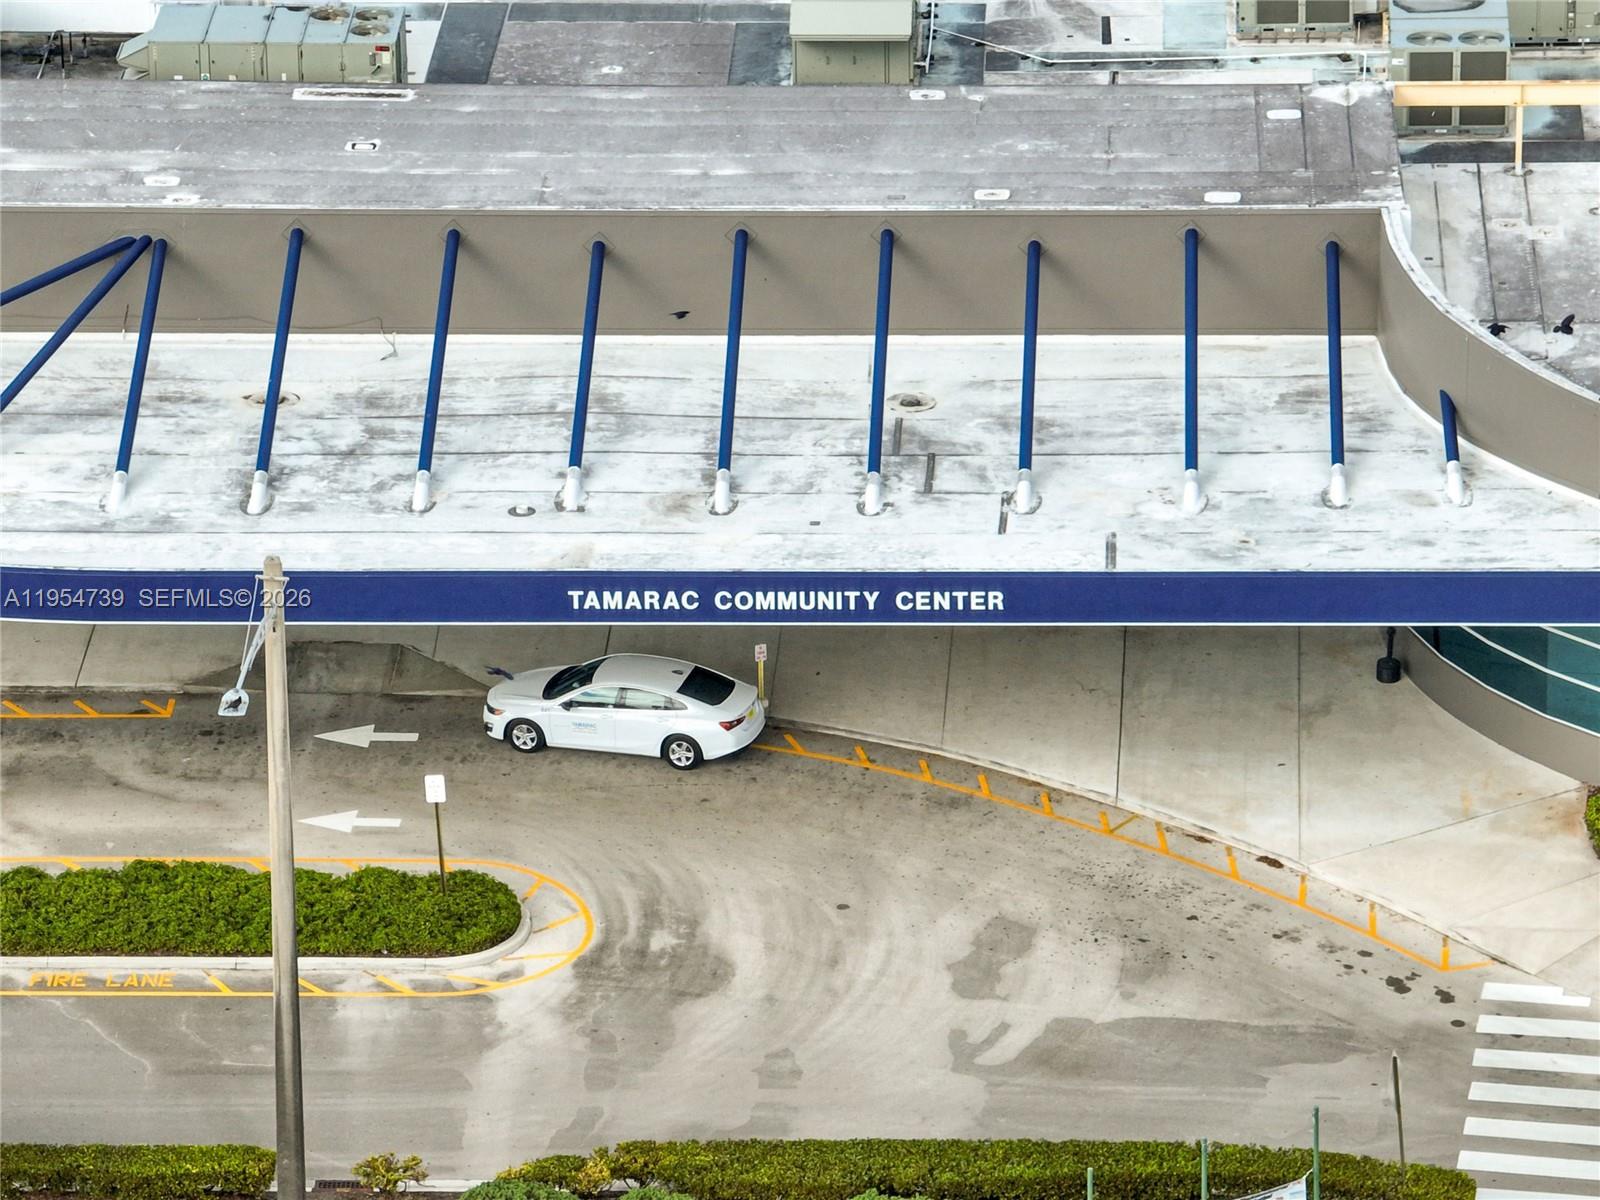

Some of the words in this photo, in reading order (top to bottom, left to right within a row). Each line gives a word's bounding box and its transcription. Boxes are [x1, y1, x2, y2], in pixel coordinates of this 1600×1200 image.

[567, 590, 699, 610] TAMARAC
[714, 590, 879, 610] COMMUNITY
[895, 590, 1004, 610] CENTER
[29, 971, 87, 987] FIRE
[106, 971, 175, 987] LANE
